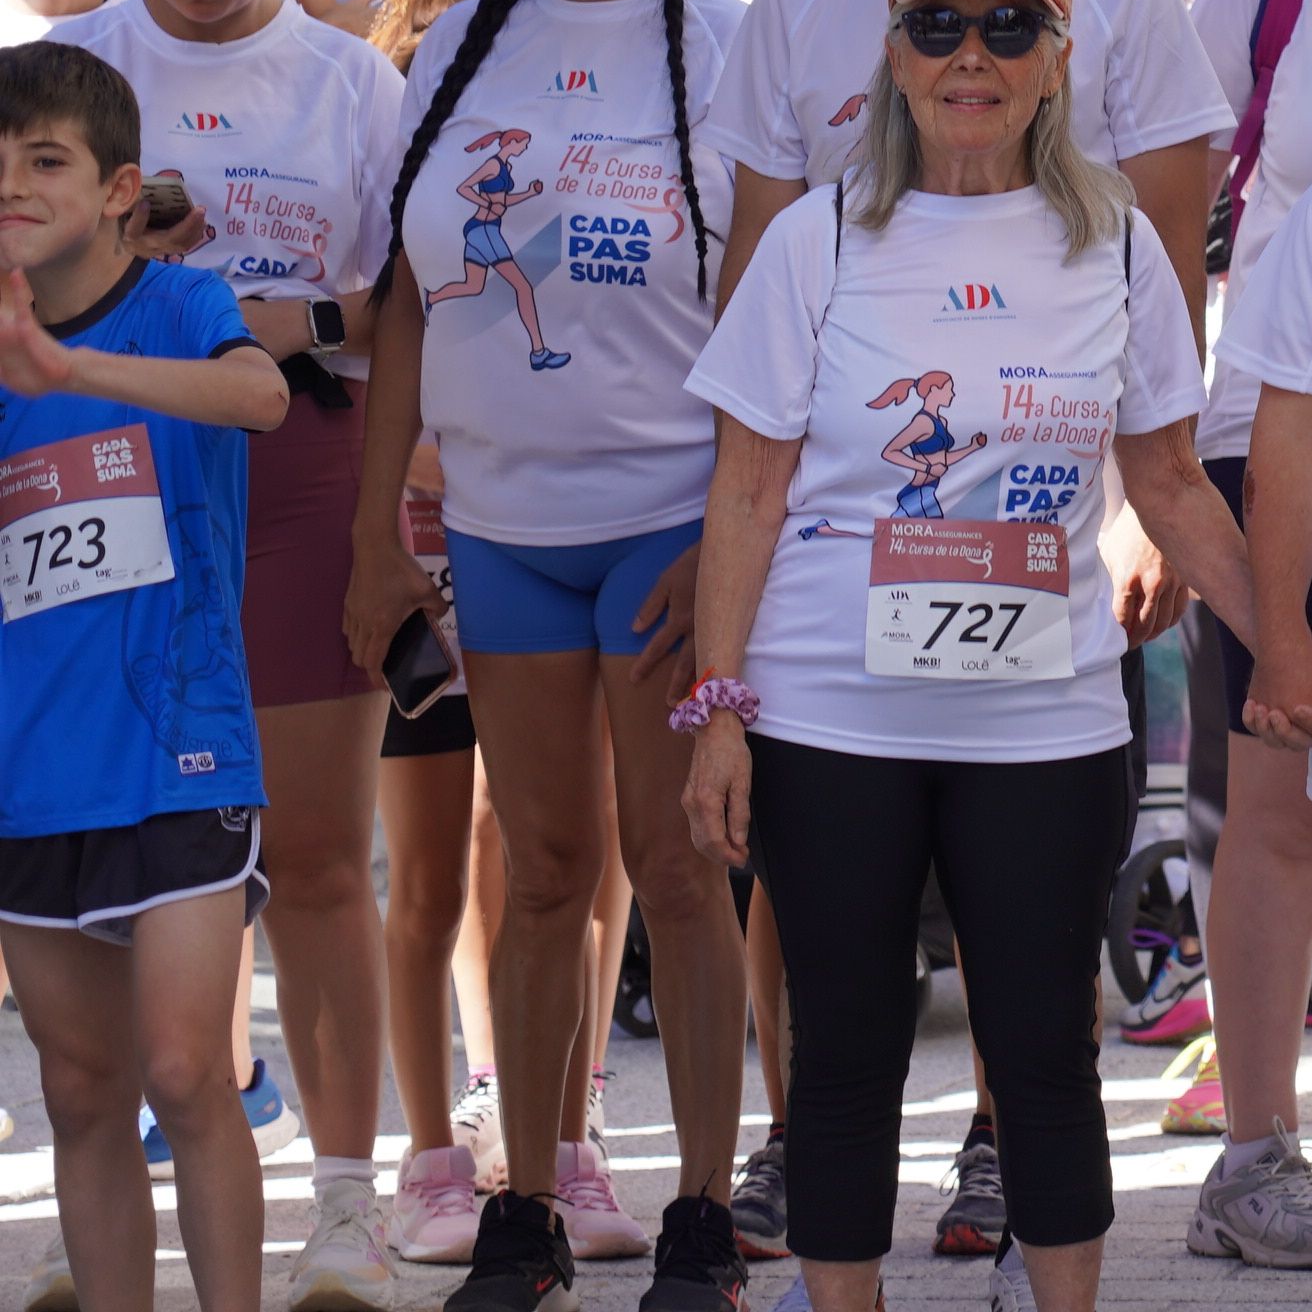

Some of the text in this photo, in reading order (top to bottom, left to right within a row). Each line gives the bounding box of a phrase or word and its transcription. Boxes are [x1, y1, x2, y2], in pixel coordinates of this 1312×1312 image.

[547, 69, 599, 94] ADA
[176, 112, 232, 131] ADA
[571, 133, 613, 142] MORA
[225, 167, 318, 187] MORA ASSEGURANCES
[605, 158, 662, 179] Cursa
[556, 175, 658, 200] de la Dona
[265, 195, 316, 222] Cursa
[227, 217, 310, 243] de la Dona
[569, 215, 651, 237] CADA
[569, 236, 651, 263] PAS
[570, 262, 647, 286] SUMA
[941, 283, 1007, 312] ADA
[1000, 366, 1048, 379] MORA
[1050, 395, 1099, 419] Cursa
[1000, 423, 1097, 445] de la Dona
[92, 438, 132, 455] CADA
[94, 449, 133, 469] PAS
[97, 465, 137, 482] SUMA
[1009, 464, 1080, 485] CADA
[1005, 489, 1076, 513] PAS
[891, 523, 934, 537] MORA
[1027, 532, 1057, 545] CADA
[24, 517, 106, 586] 723
[909, 544, 934, 556] Cursa
[935, 545, 947, 556] de
[959, 545, 981, 558] Dona
[1027, 544, 1058, 558] PAS
[1026, 558, 1058, 573] SUMA
[922, 601, 1027, 652] 727
